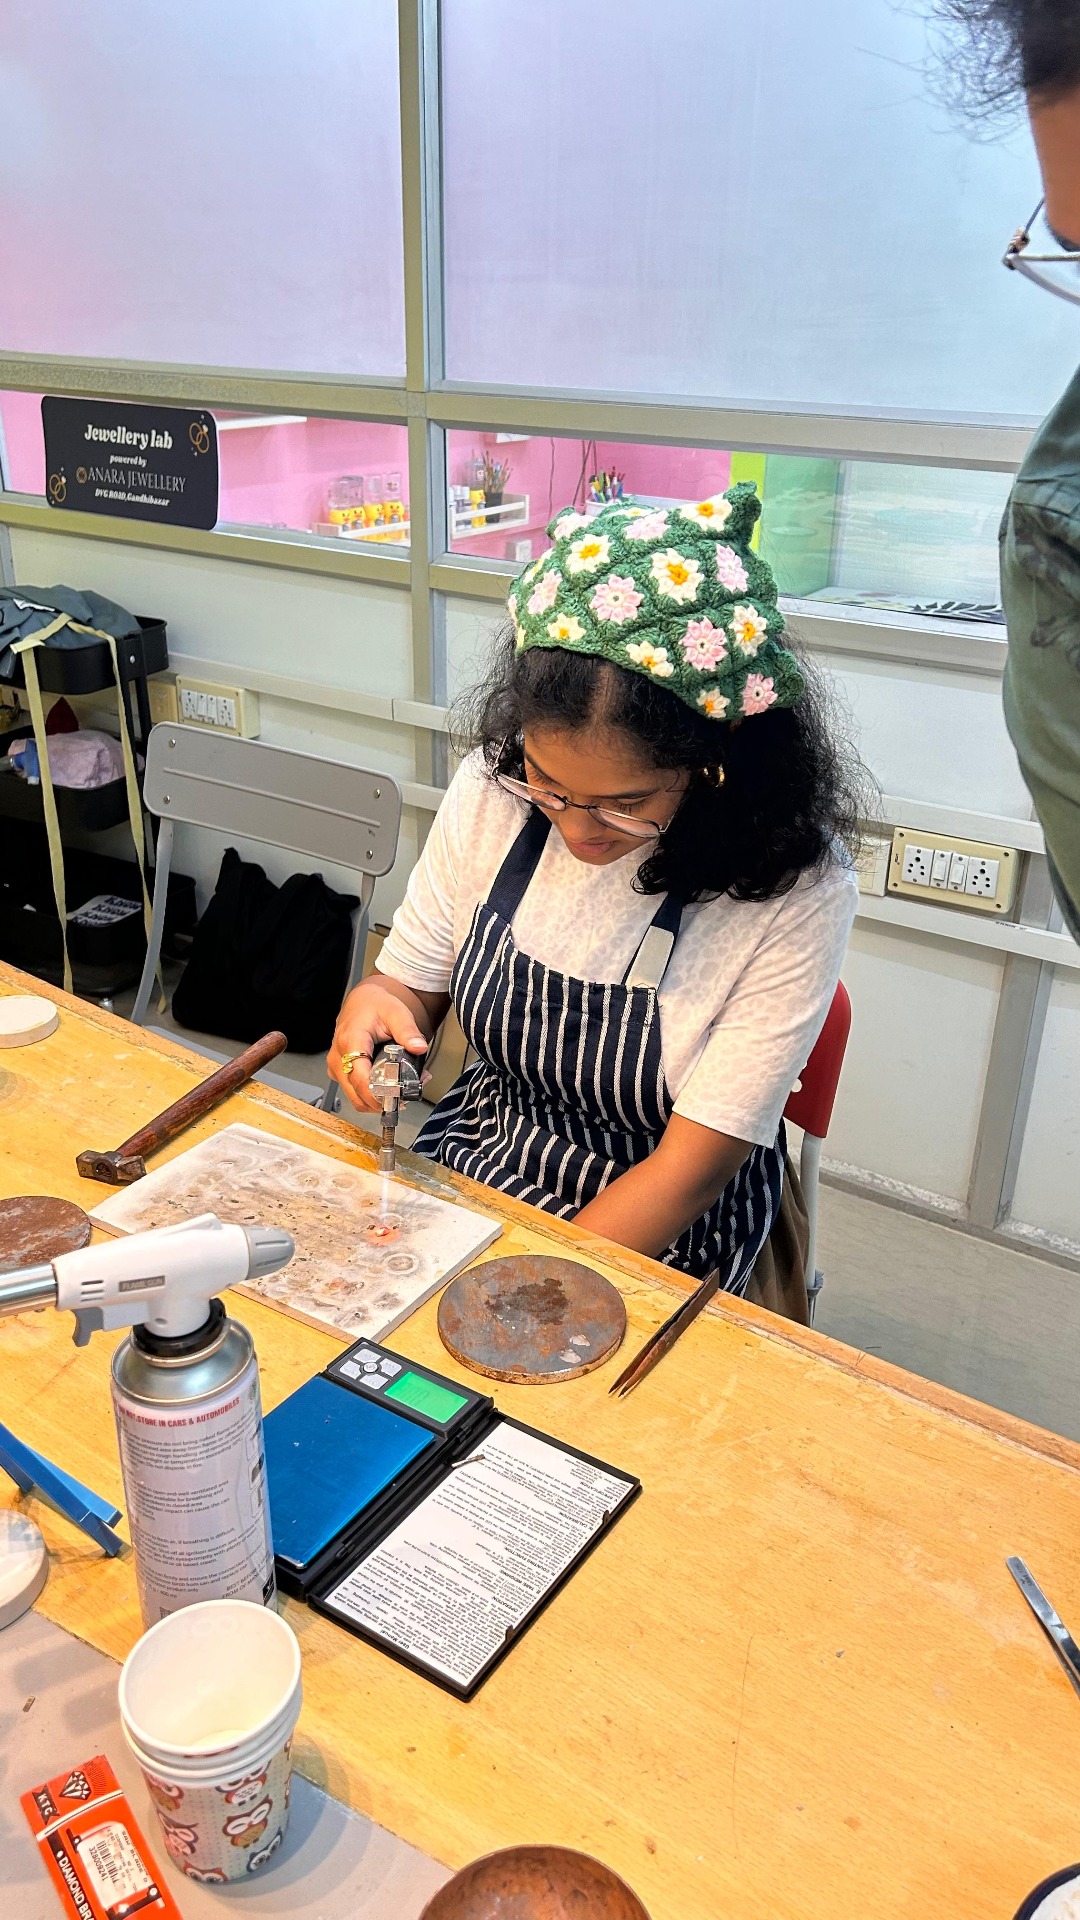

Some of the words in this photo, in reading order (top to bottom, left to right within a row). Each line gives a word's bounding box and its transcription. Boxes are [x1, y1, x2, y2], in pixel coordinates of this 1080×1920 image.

[85, 424, 148, 450] Jewellery
[150, 429, 173, 449] lab
[110, 454, 138, 464] powered
[138, 457, 147, 467] by
[88, 467, 126, 484] ANARA
[127, 469, 187, 492] JEWELLERY
[137, 1416, 157, 1426] STORE
[168, 1419, 187, 1427] CARS
[197, 1397, 240, 1423] AUTOMOBILES
[37, 1792, 53, 1815] KTC
[88, 1846, 108, 1881] 328009241
[57, 1856, 84, 1905] DIAMOND
